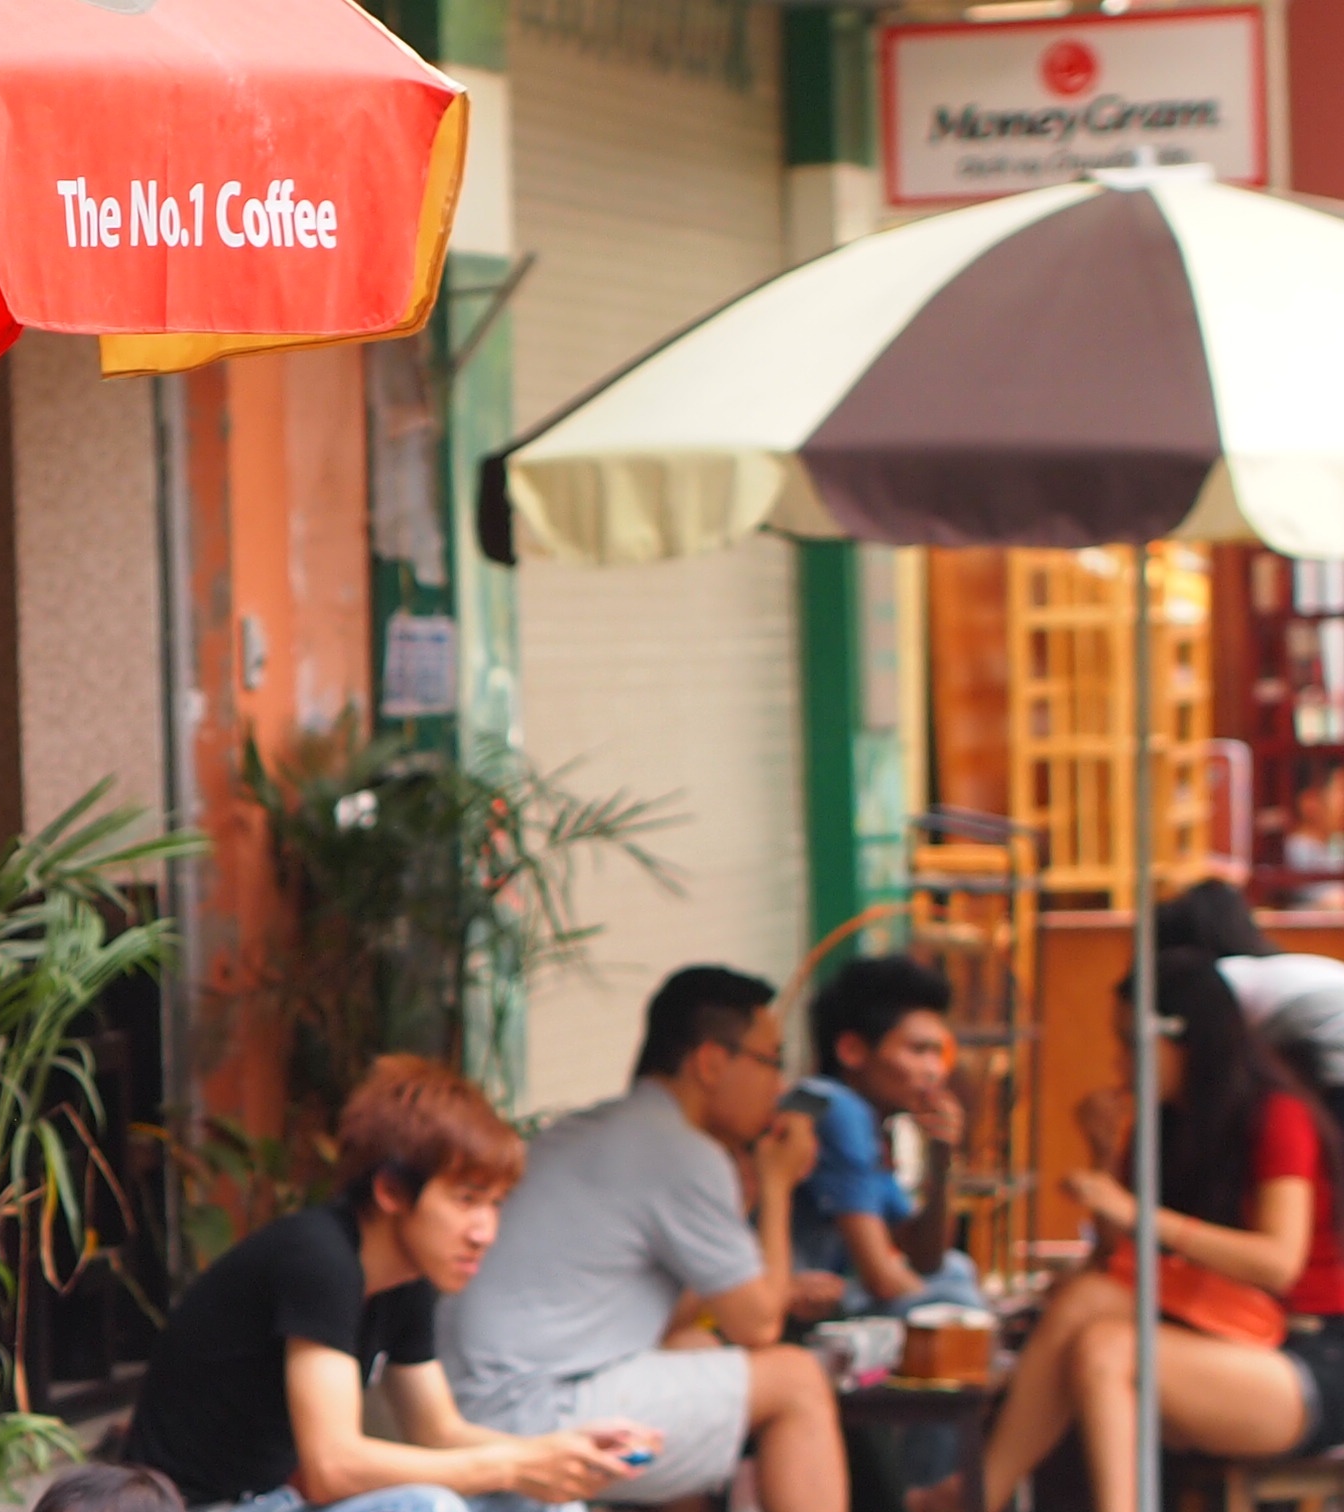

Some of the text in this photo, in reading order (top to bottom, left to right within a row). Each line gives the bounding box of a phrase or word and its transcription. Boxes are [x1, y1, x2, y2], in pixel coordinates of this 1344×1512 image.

[57, 177, 338, 249] The No.1 Coffee
